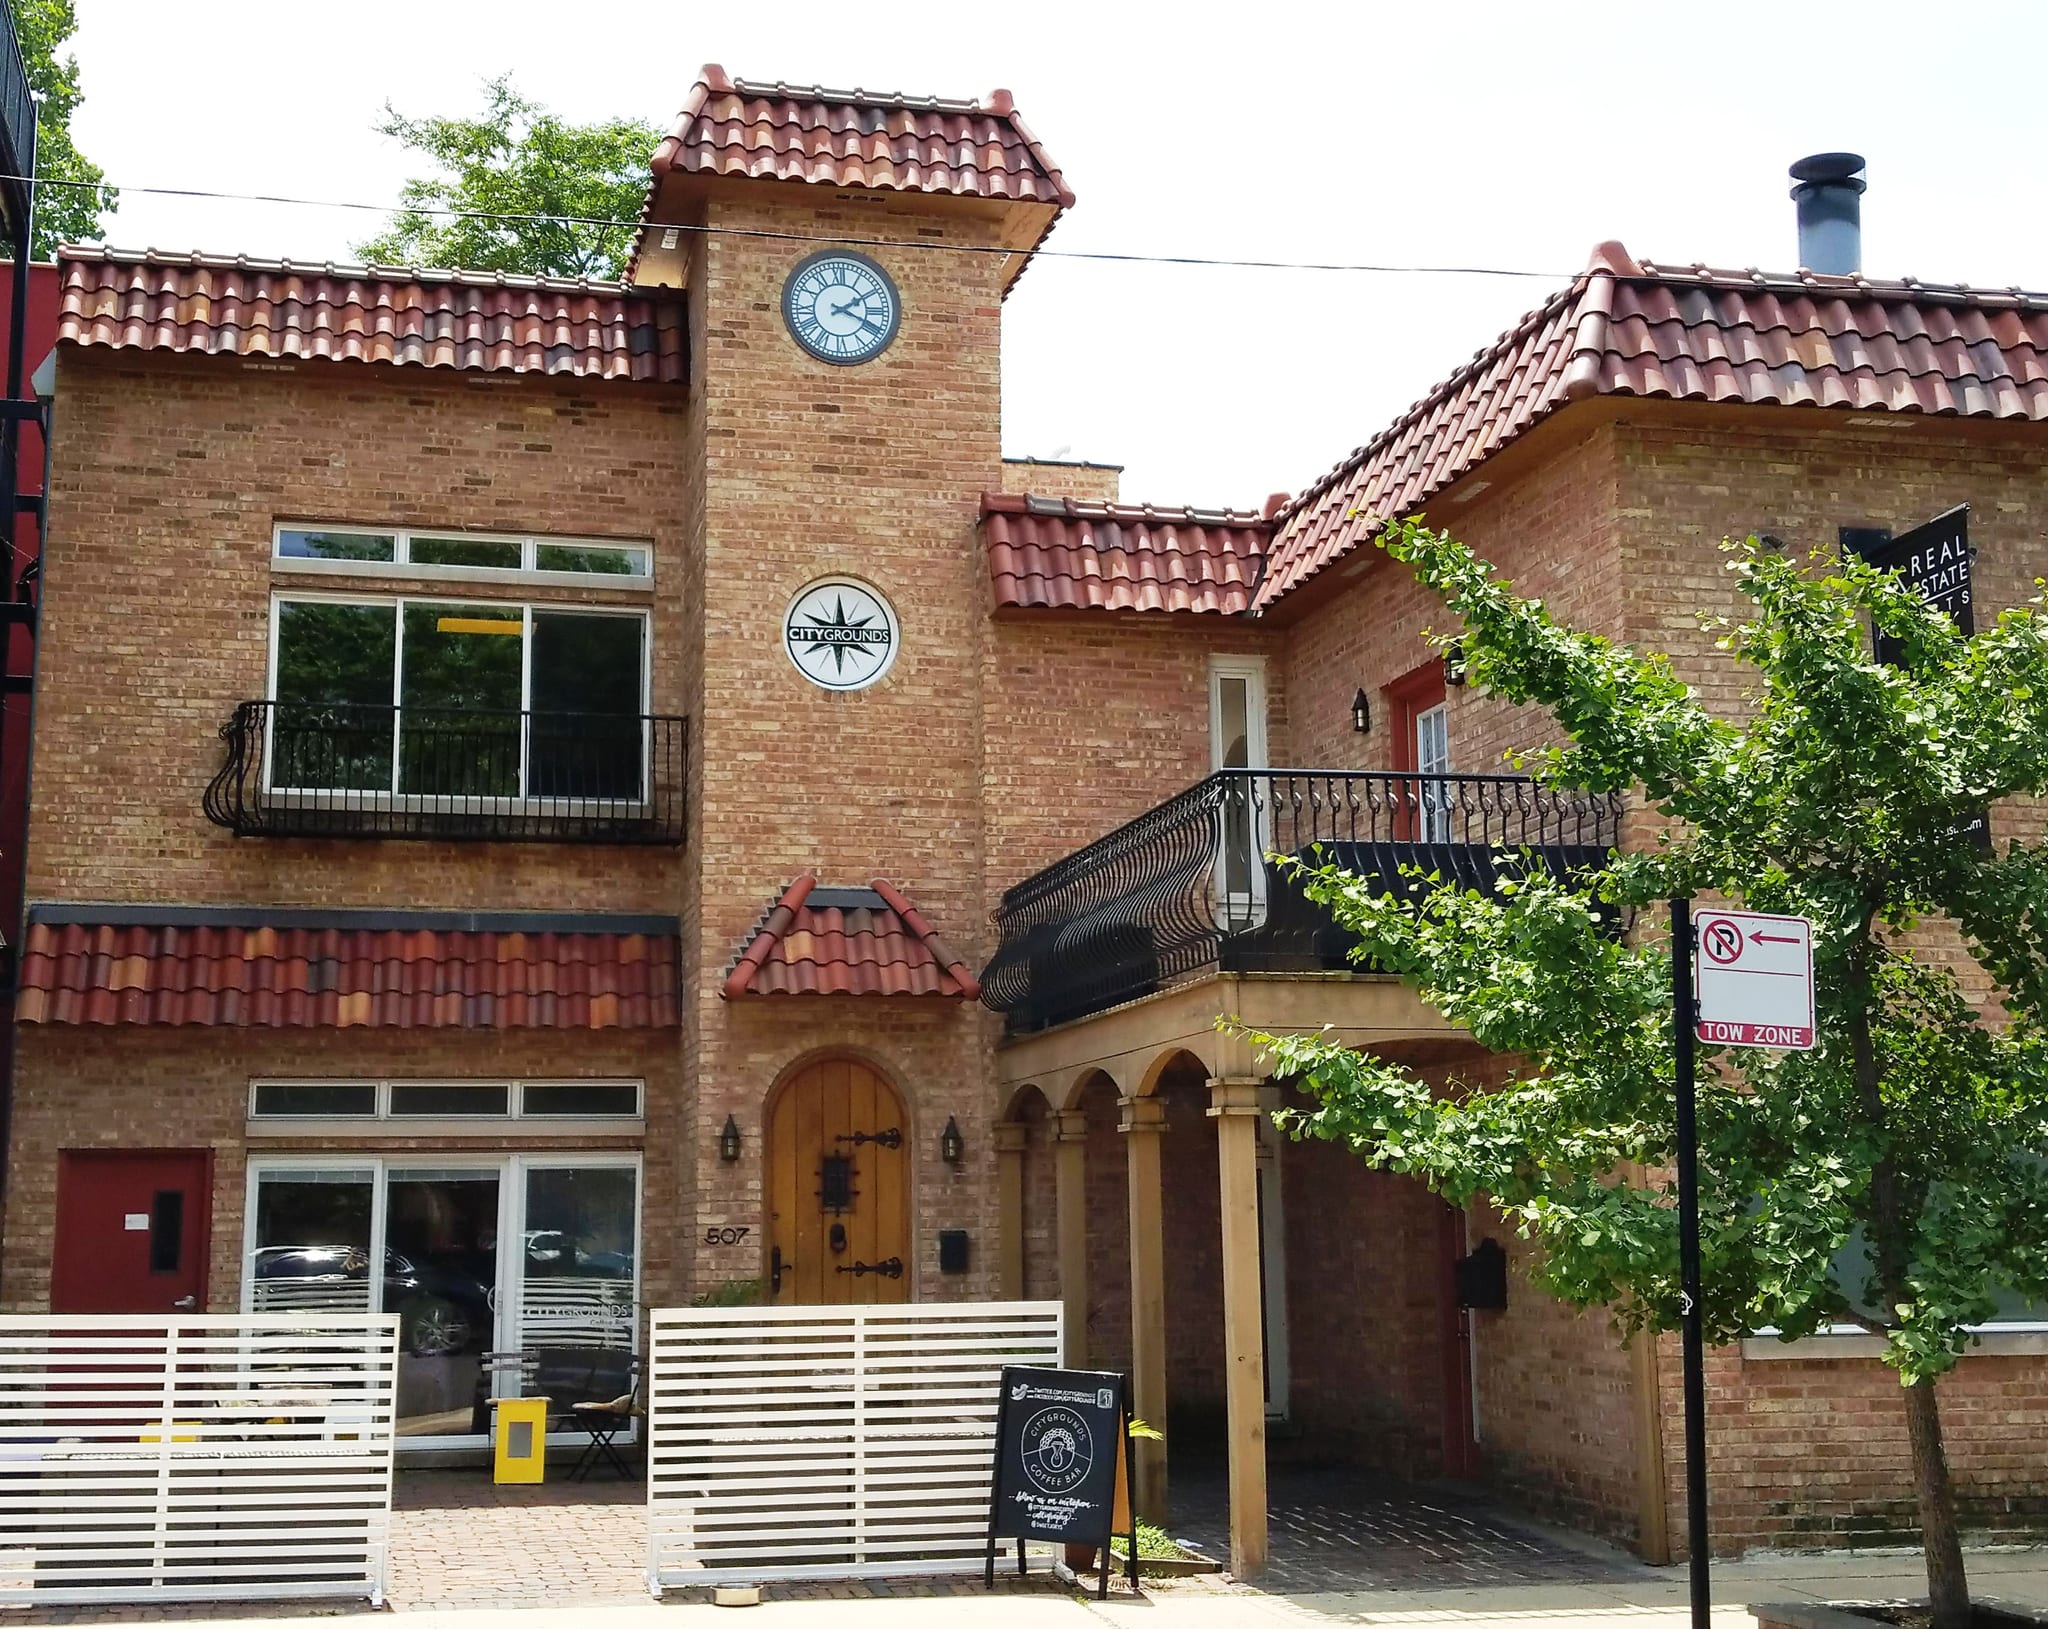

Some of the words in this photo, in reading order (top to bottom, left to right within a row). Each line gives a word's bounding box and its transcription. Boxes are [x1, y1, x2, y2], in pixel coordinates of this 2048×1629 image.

[1911, 535, 1966, 577] REAL
[1917, 561, 1968, 594] STATE
[789, 628, 889, 642] CITYGROUNDS
[1704, 1022, 1743, 1040] TOW
[1754, 1026, 1803, 1045] ZONE
[704, 1227, 750, 1245] 507
[1030, 1413, 1087, 1441] CITYGROUNDS
[1030, 1463, 1062, 1486] COFFEE
[1065, 1467, 1082, 1483] BAR
